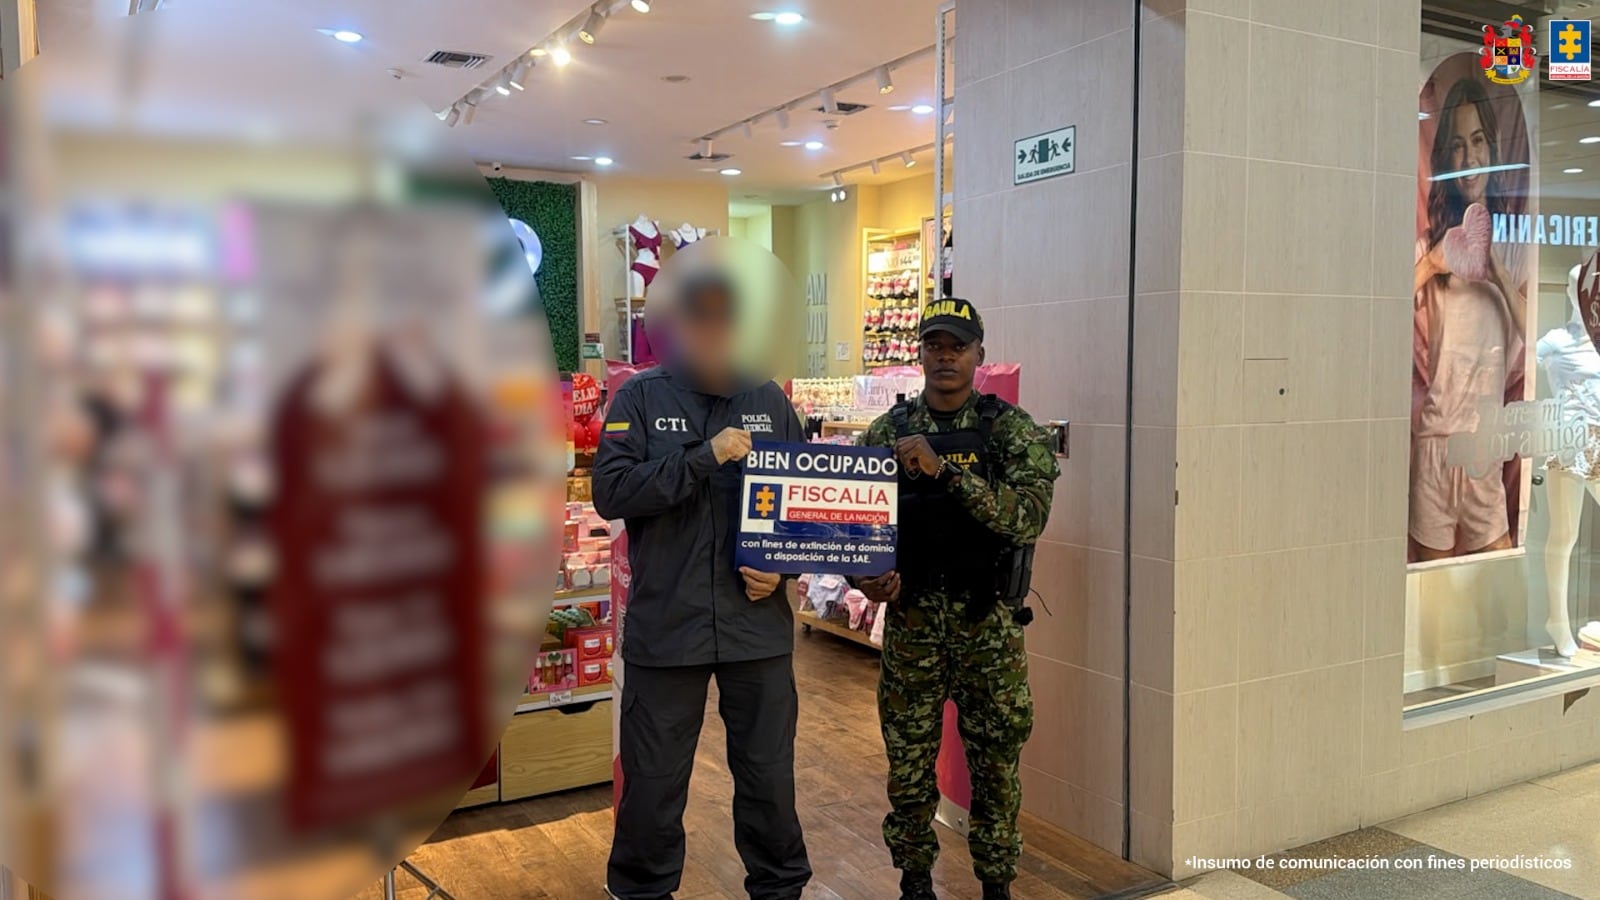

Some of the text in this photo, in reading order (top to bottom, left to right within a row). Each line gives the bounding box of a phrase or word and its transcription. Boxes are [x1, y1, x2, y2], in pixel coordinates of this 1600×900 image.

[573, 386, 599, 402] ELIZ
[655, 417, 689, 432] CTI
[747, 450, 898, 476] BIEN OCUPADO
[788, 485, 890, 505] FISCALÍA
[788, 510, 888, 523] GENERAL DE LA NACIÓN
[741, 539, 895, 553] con fines de extinción de dominio
[774, 551, 825, 564] disposición
[826, 554, 839, 562] de
[841, 553, 850, 562] la
